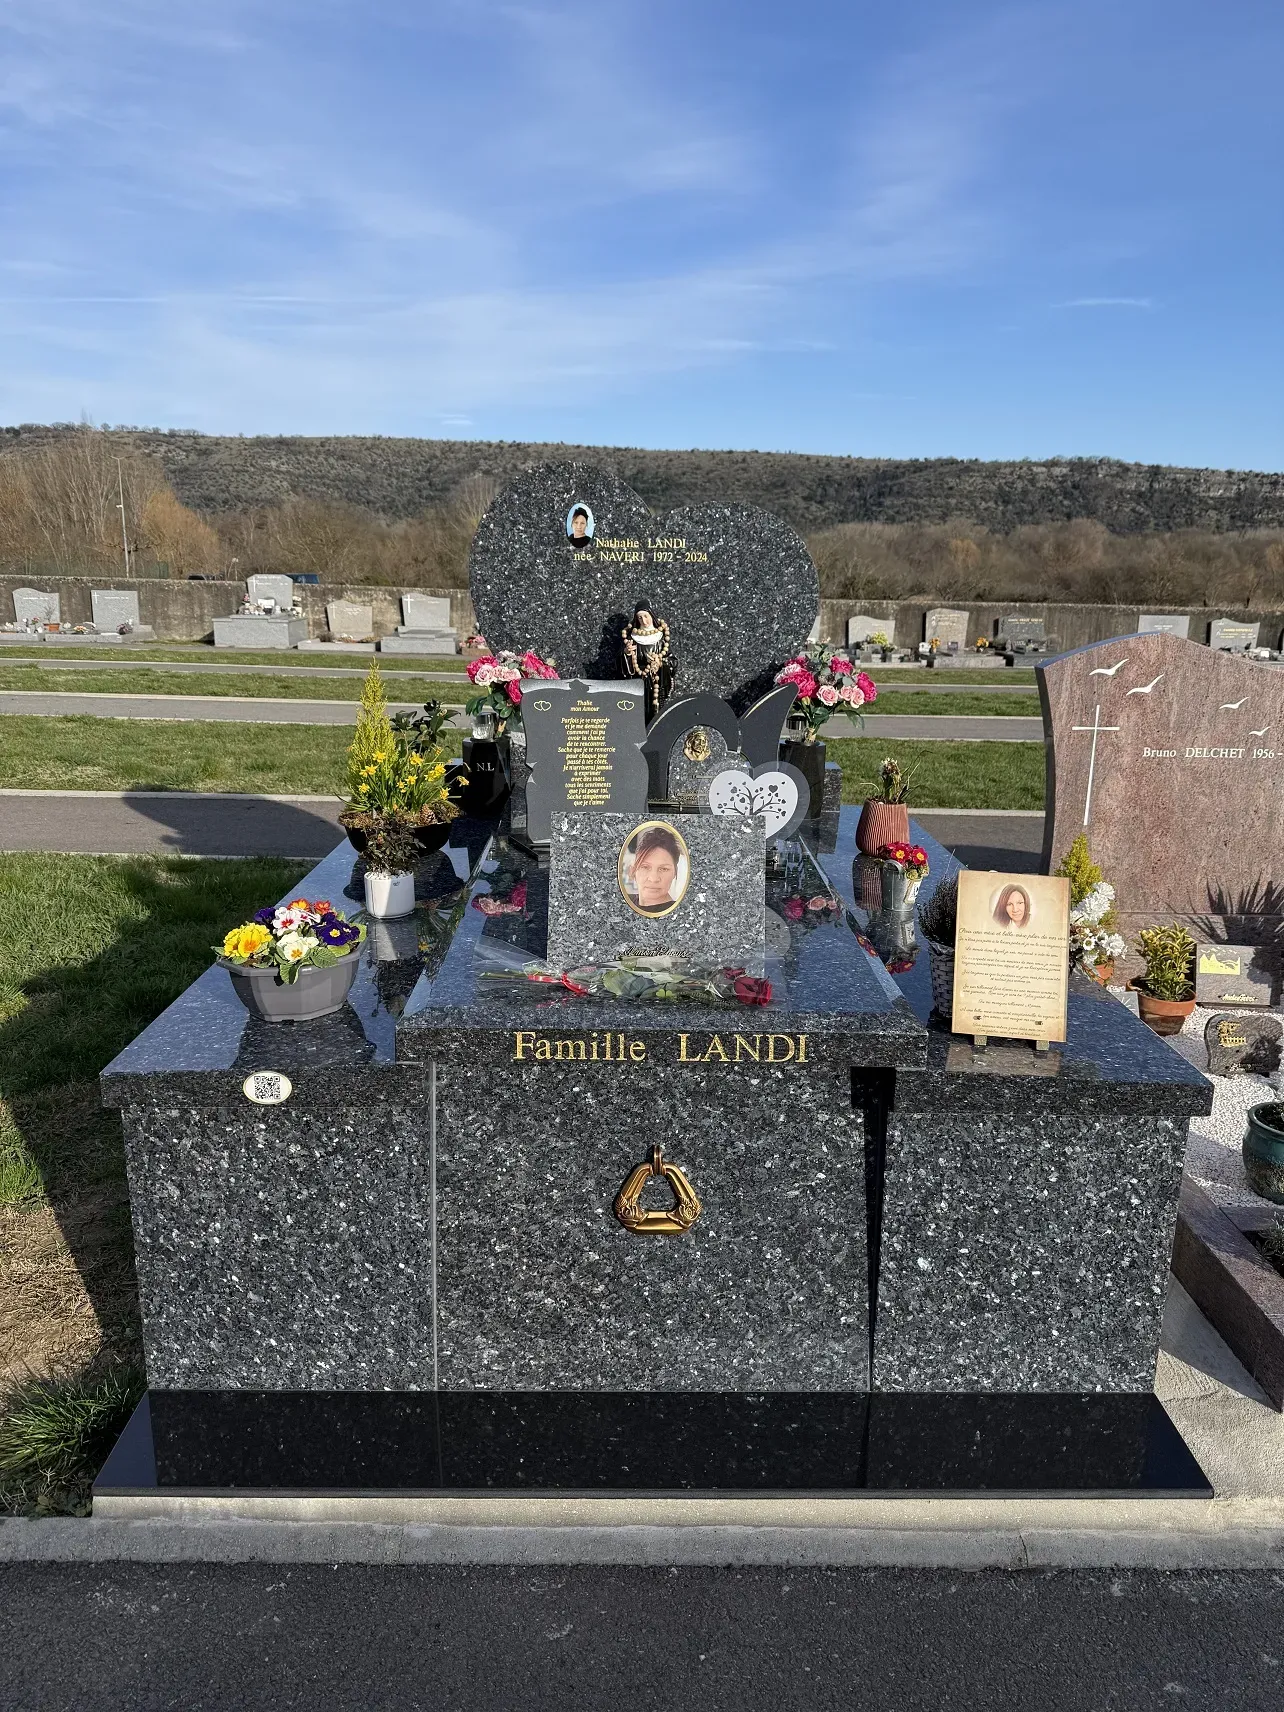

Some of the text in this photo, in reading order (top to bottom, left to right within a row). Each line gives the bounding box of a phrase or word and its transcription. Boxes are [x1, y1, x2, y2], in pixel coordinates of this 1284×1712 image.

[596, 538, 687, 549] Nathalie LANDI
[574, 552, 592, 562] née
[600, 552, 644, 562] NAVERI
[653, 552, 673, 562] 1972
[685, 552, 708, 562] 2024
[579, 752, 597, 760] chaque
[1142, 747, 1177, 758] Bruno
[1185, 747, 1246, 759] DELCHET
[1252, 748, 1275, 759] 1956
[582, 793, 611, 801] simplement
[513, 1031, 810, 1063] Famille LANDI
